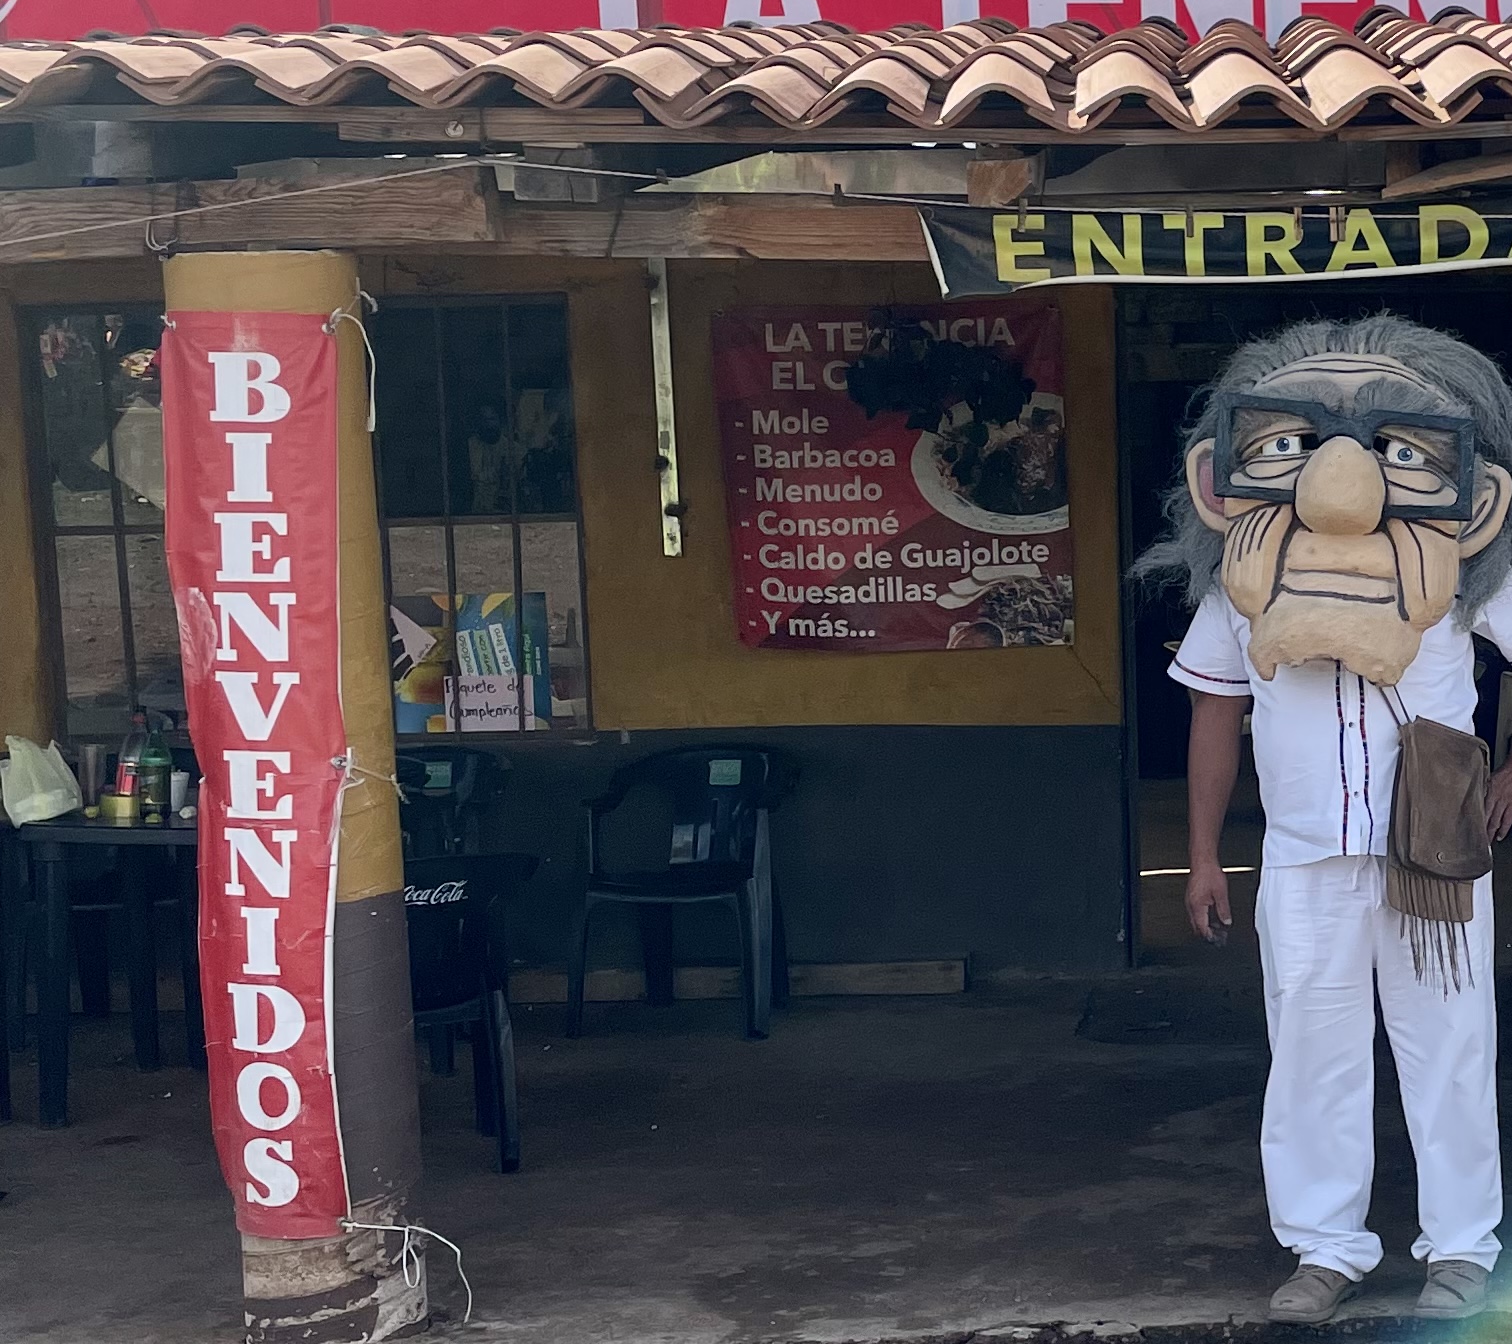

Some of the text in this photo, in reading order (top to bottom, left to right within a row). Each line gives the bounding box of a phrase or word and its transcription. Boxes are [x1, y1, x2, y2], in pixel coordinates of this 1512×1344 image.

[765, 322, 812, 353] LA
[772, 361, 815, 391] EL
[752, 409, 829, 436] Mole
[753, 443, 896, 469] Barbacoa
[755, 476, 883, 503] Menudo
[757, 510, 899, 537] Consomé
[759, 538, 1050, 573] Caldo de Guajolote
[761, 576, 937, 605] Quesadillas
[761, 610, 876, 638] Y más...
[445, 677, 497, 698] Pquete
[207, 351, 305, 1207] BIENVENIDOS
